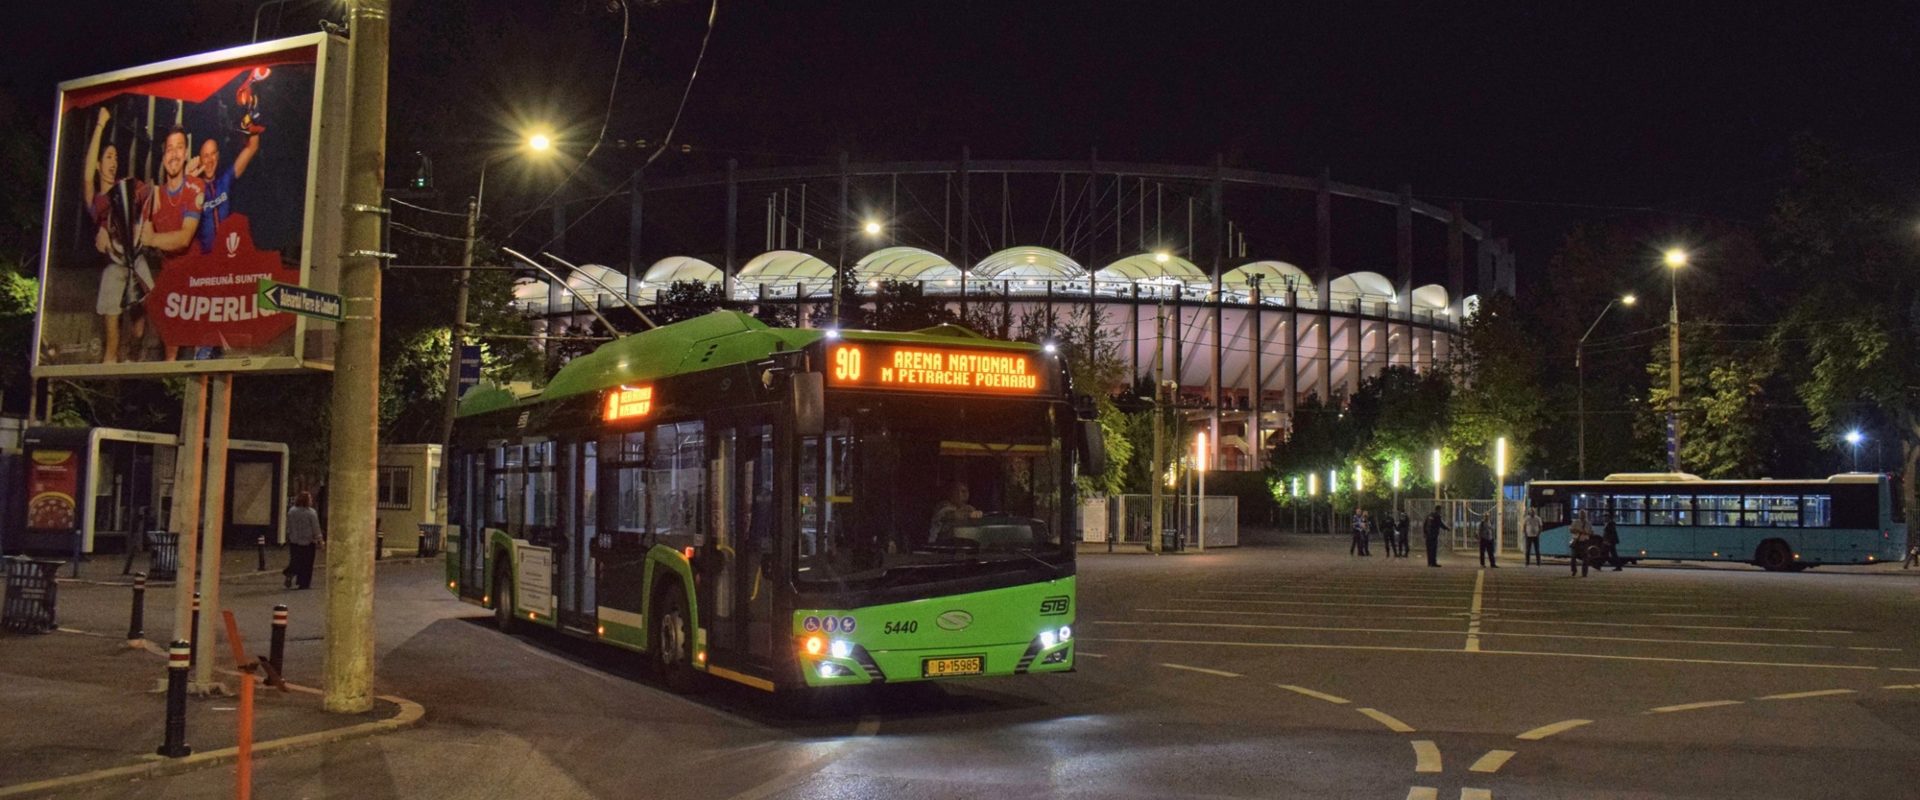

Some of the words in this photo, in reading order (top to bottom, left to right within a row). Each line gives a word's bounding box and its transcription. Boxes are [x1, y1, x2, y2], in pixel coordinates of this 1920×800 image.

[836, 347, 861, 380] 90
[894, 351, 942, 370] ARENA
[949, 354, 1025, 374] NATIONALA
[881, 367, 893, 382] M
[899, 370, 970, 385] PETRACHE
[976, 373, 1036, 388] POENARU
[1039, 599, 1067, 612] STB
[884, 620, 918, 635] 5440
